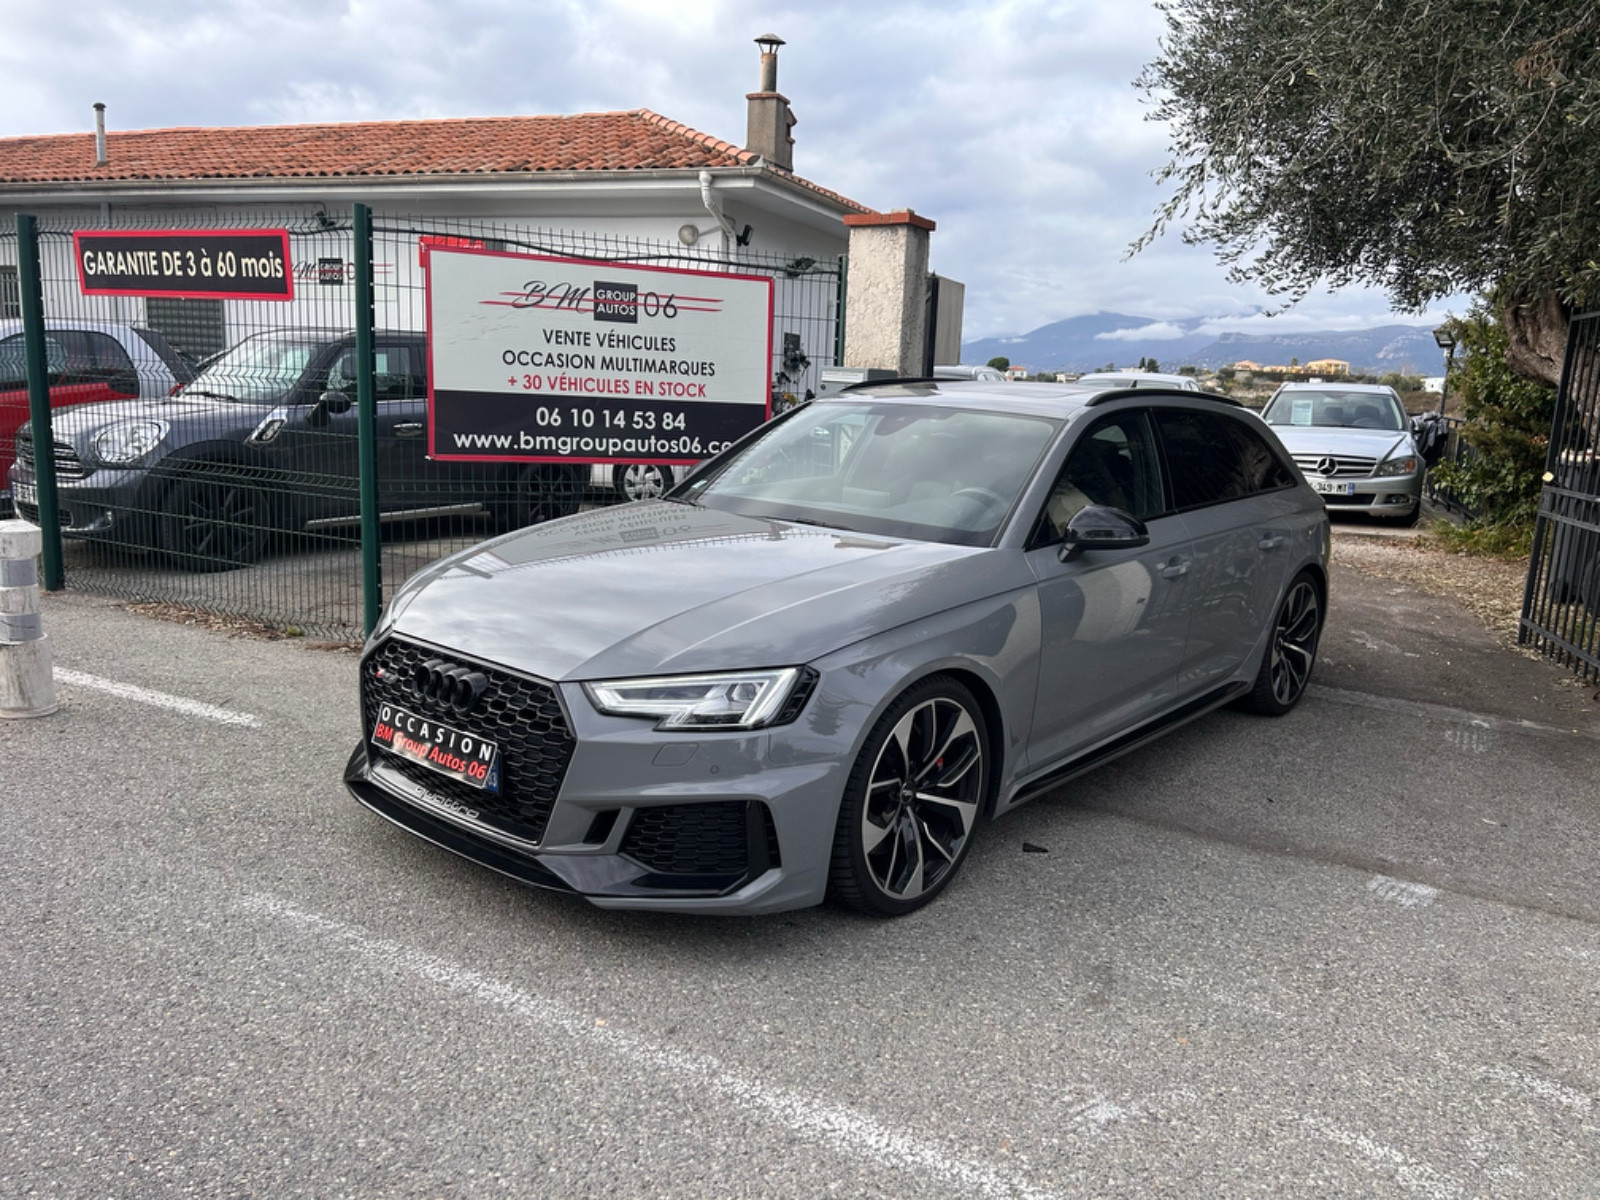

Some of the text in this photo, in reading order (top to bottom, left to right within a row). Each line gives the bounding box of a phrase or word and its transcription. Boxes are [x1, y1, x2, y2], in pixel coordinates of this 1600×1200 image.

[83, 248, 284, 279] GARANTIE DE 3 à 60 mois
[511, 280, 679, 319] BM GROUP 06
[596, 302, 636, 317] AUTOS
[542, 328, 677, 353] VENTE VÉHICULES
[502, 350, 716, 377] OCCASION MULTIMARQUES
[507, 372, 707, 398] + 30 VÉHICULES EN STOCK
[535, 407, 687, 431] 06 10 14 53 84
[453, 430, 733, 456] www.bmgroupautos06.co
[382, 706, 493, 761] OCCASION
[375, 723, 488, 780] BM Group Autos 06
[415, 785, 480, 819] quattro
